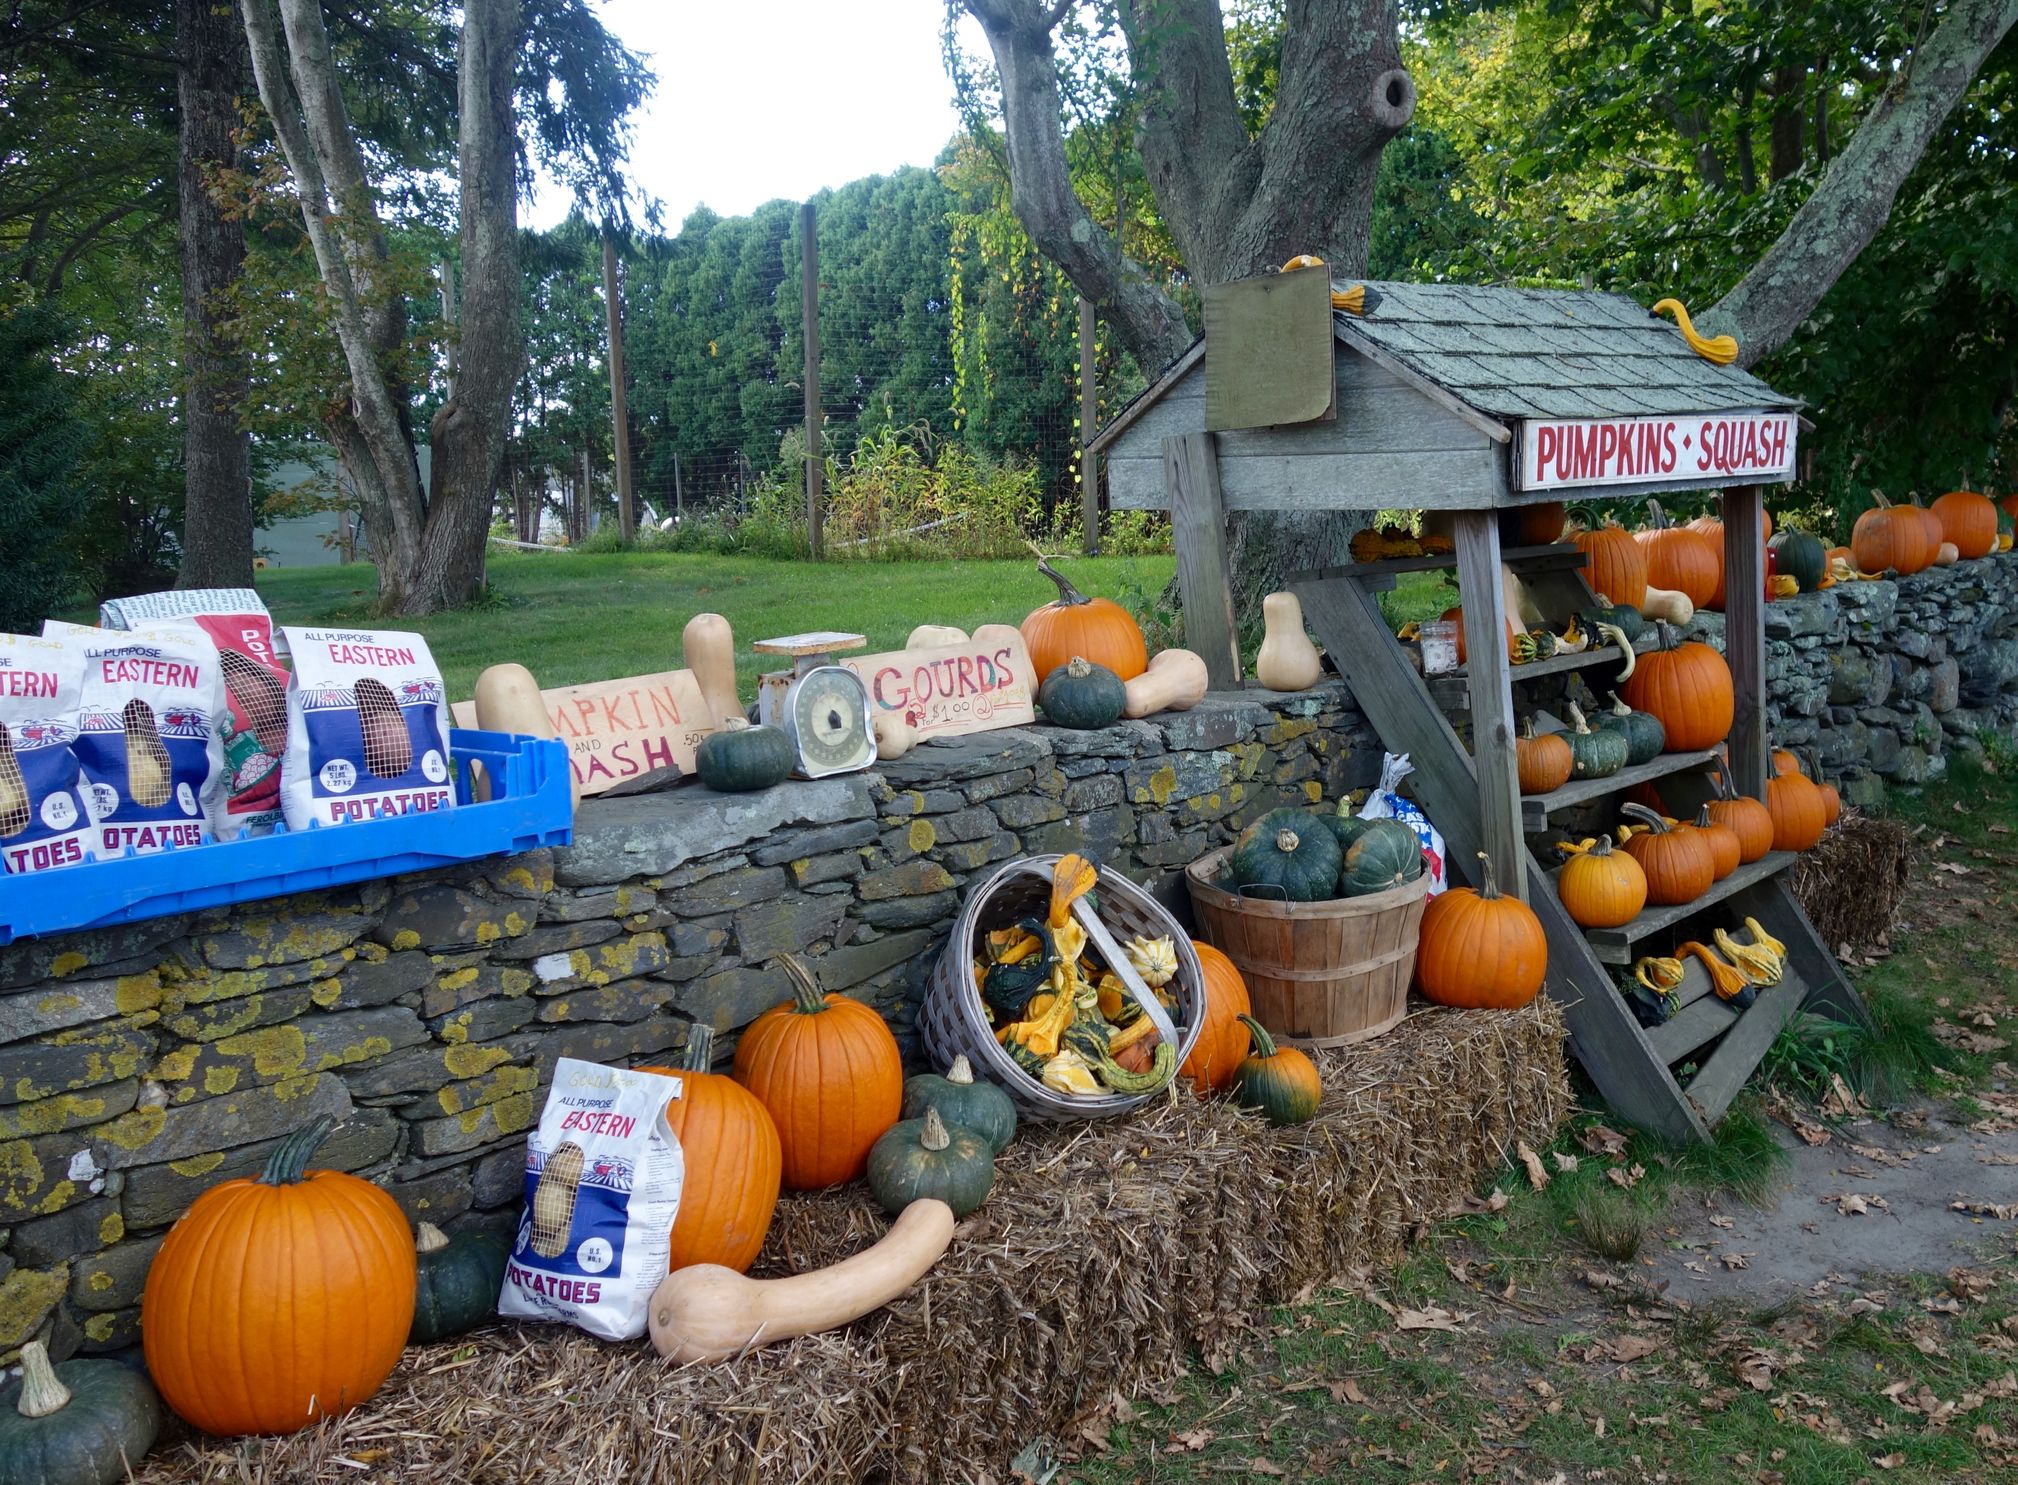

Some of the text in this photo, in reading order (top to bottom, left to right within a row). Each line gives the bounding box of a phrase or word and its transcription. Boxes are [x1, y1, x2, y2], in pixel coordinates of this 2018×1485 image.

[1536, 420, 1788, 482] PUMPKINS SQUASH
[241, 629, 274, 668] POT
[305, 632, 375, 643] ALL PURPOSE
[104, 647, 161, 658] PURPOSE
[328, 643, 416, 667] EASTERN
[0, 671, 58, 698] TERN
[102, 659, 199, 689] EASTERN
[873, 647, 1013, 711] GOURDS
[548, 685, 681, 738] MPKIN
[568, 735, 675, 785] ASH
[574, 739, 601, 754] AND
[330, 791, 450, 821] POTATOES
[103, 824, 202, 850] OTATOES
[4, 837, 82, 874] TOES
[558, 1096, 614, 1109] ALL PURPOSE
[560, 1110, 638, 1139] EASTERN
[589, 1247, 602, 1255] U.S.
[507, 1262, 602, 1304] POTATOES
